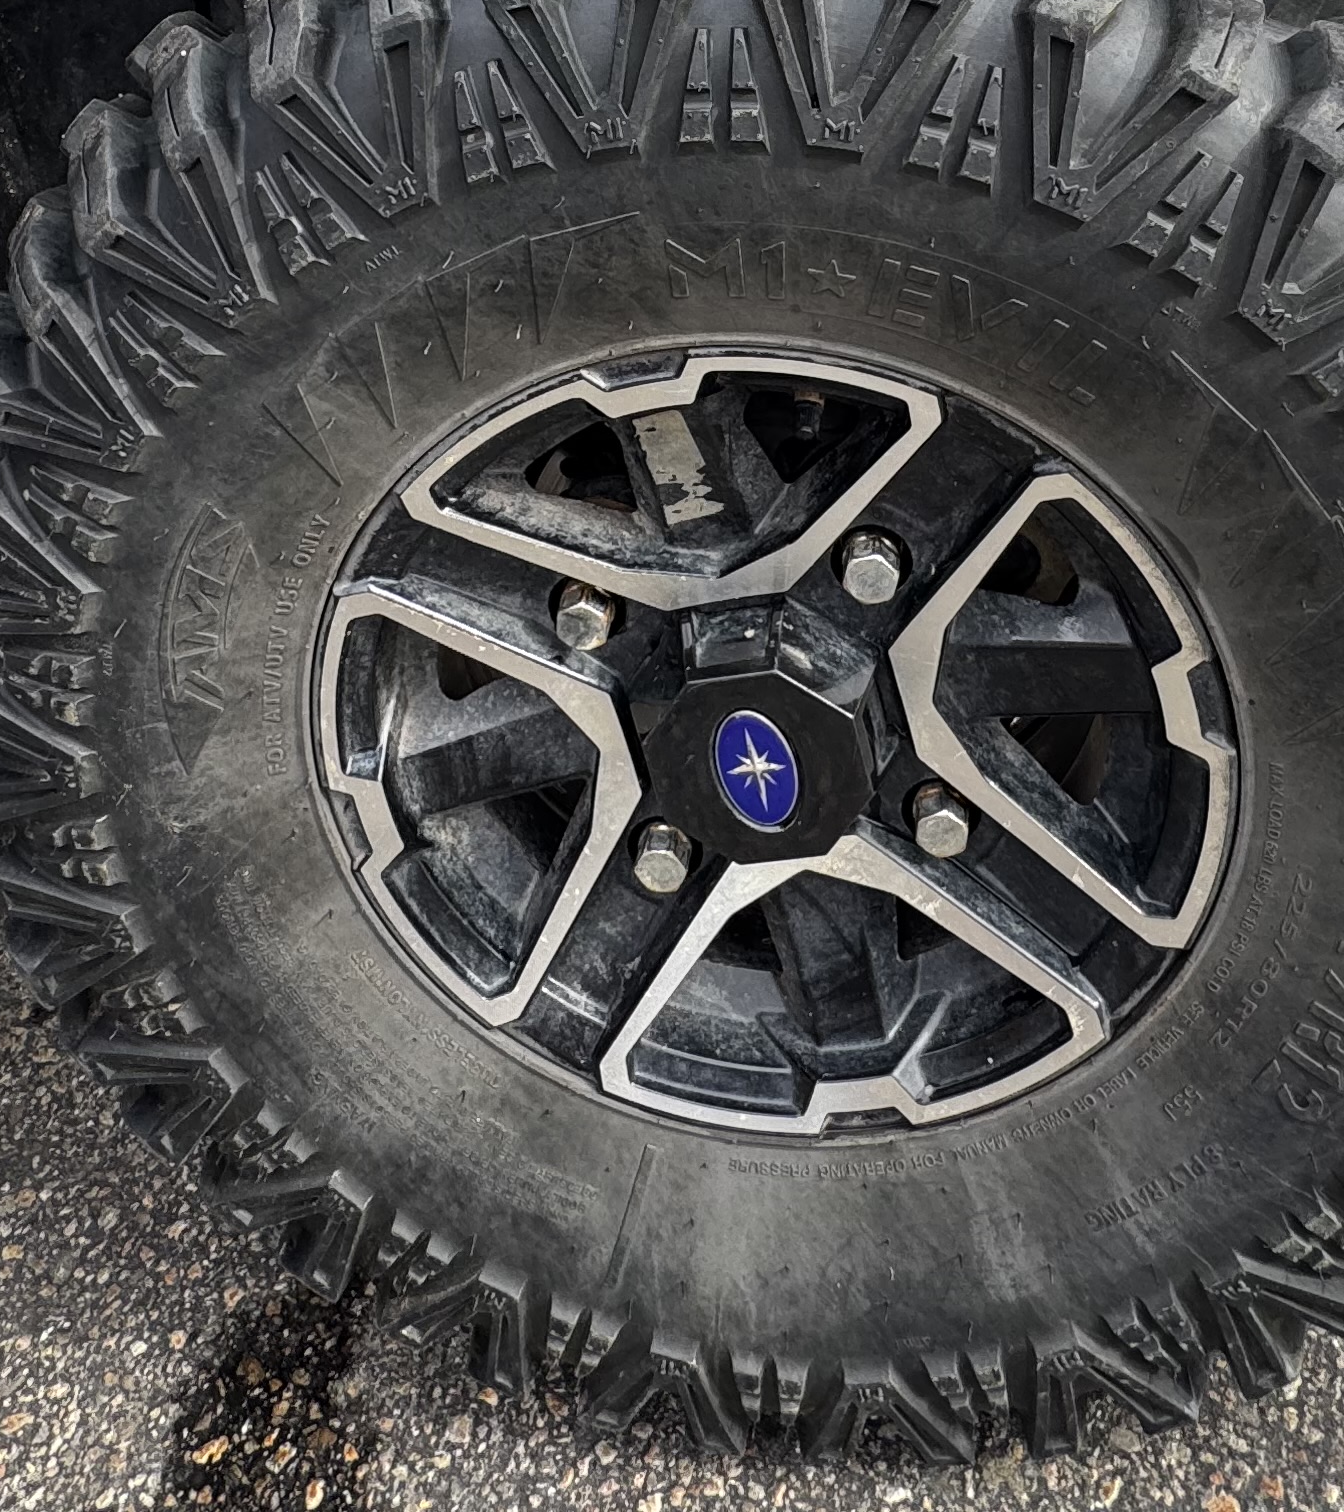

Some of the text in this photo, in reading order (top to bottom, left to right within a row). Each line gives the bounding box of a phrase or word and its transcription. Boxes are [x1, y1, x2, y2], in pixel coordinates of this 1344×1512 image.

[665, 237, 788, 301] M1
[262, 512, 331, 775] FOR ATV/UTV USE ONLY
[1265, 800, 1284, 840] LOAD
[1165, 1155, 1211, 1191] PLY
[1084, 1181, 1169, 1231] RATING
